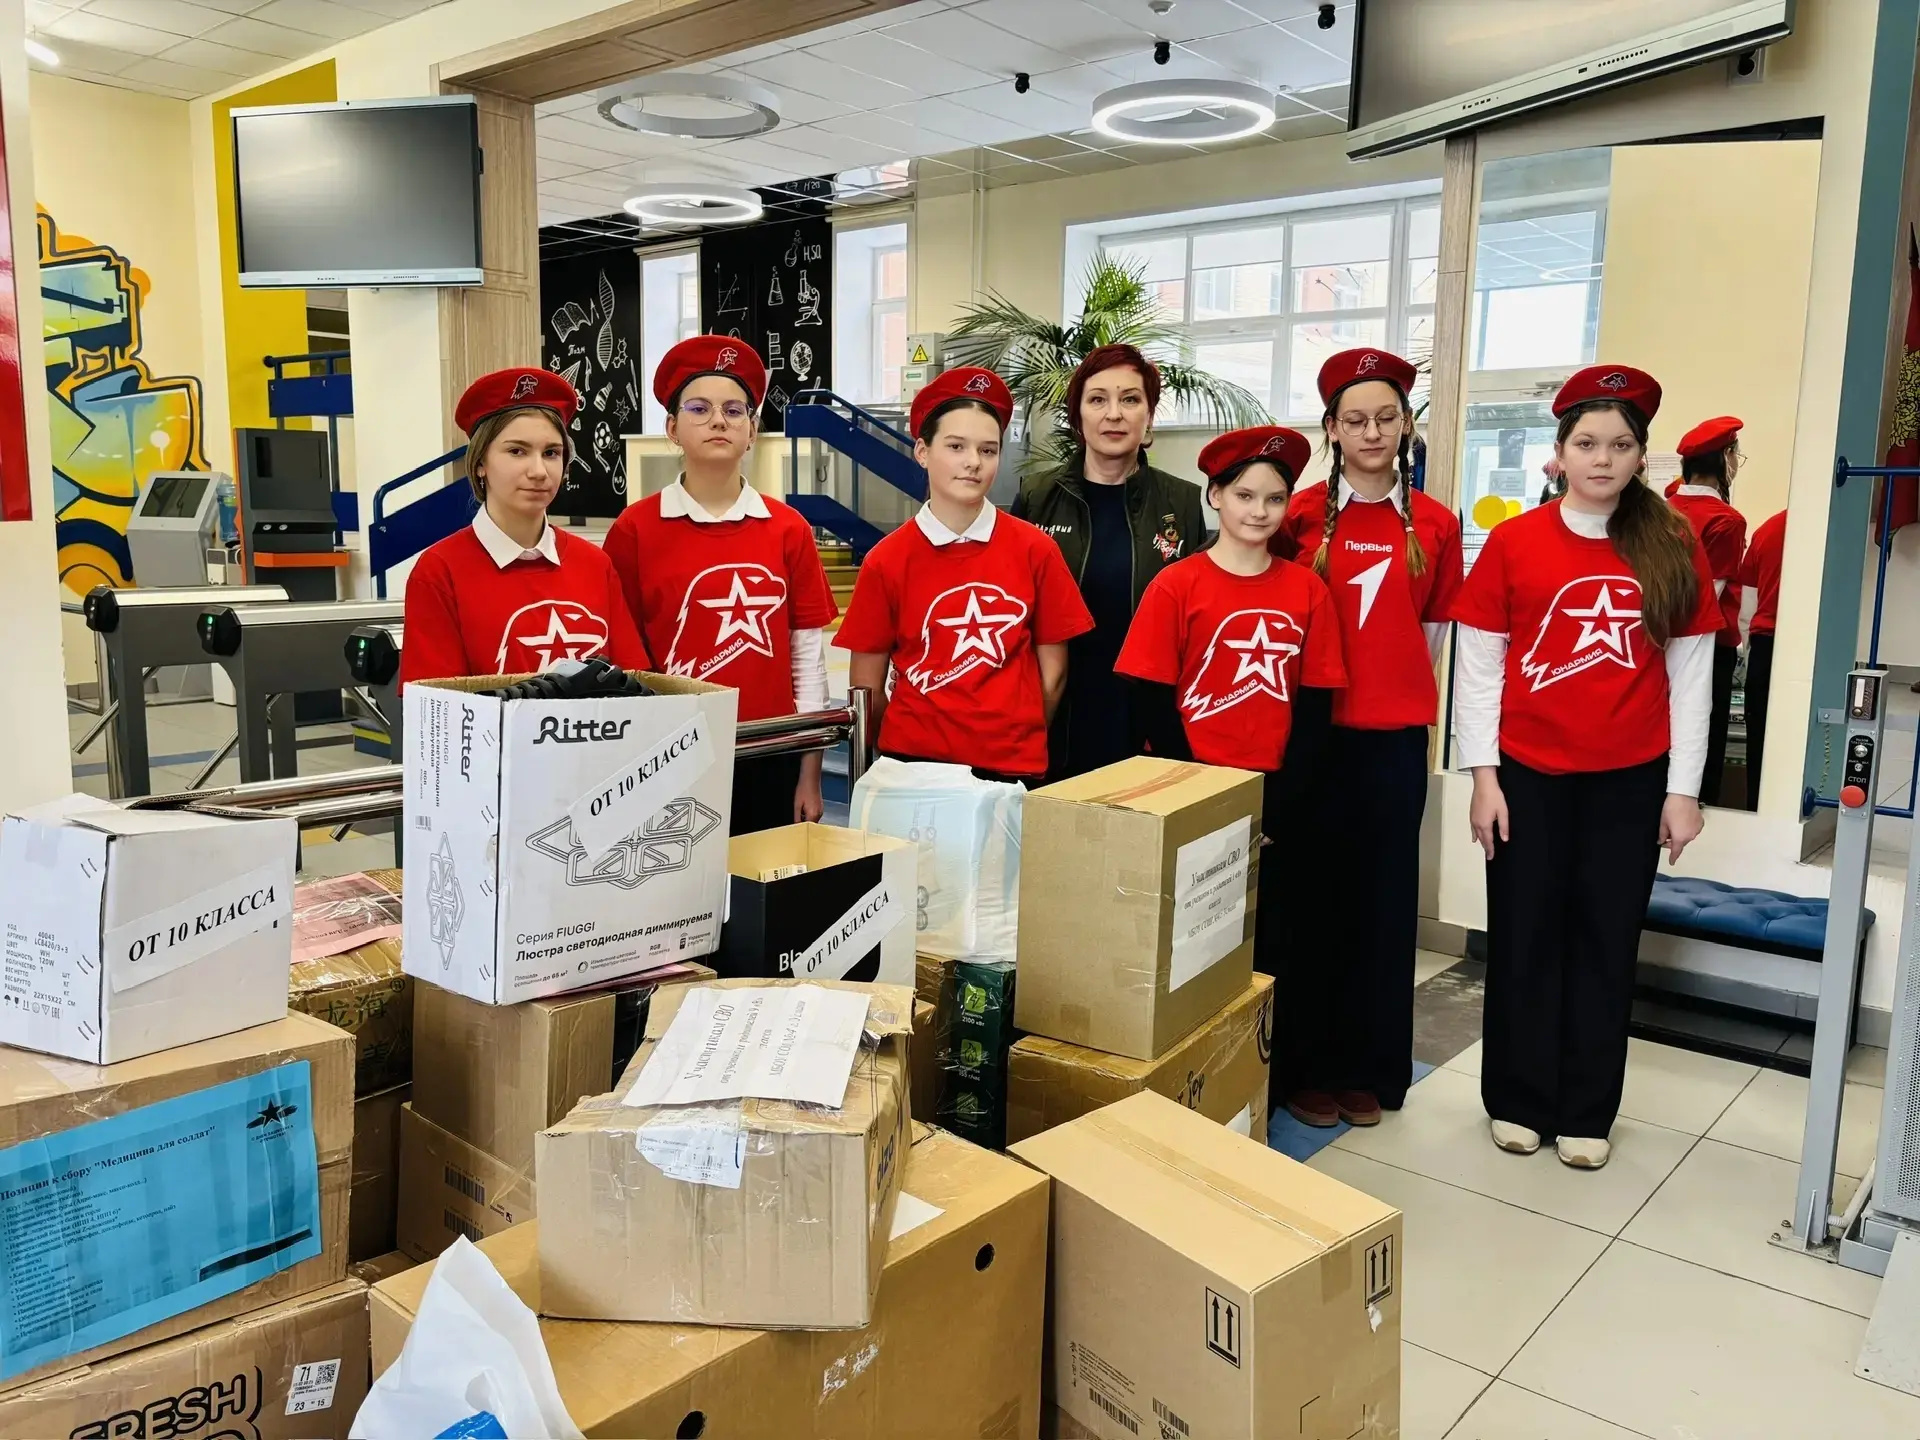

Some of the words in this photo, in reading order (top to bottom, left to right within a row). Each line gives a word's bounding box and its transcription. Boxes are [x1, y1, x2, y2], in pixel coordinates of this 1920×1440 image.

[1345, 540, 1393, 553] Первые
[699, 637, 744, 672] ЮНАРМИЯ
[933, 653, 978, 683] ЮНАРМИЯ
[1551, 648, 1603, 676] ЮНАРМИЯ
[1213, 679, 1258, 707] ЮНАРМИЯ
[461, 703, 475, 783] Ritter
[533, 716, 631, 745] Ritter
[590, 788, 614, 818] ОТ
[618, 775, 634, 799] 10
[637, 728, 700, 784] КЛАССА
[129, 932, 160, 962] ОТ
[168, 922, 188, 949] 10
[195, 885, 276, 936] КЛАССА
[515, 946, 564, 962] Люстра
[566, 928, 644, 952] светодиодная
[644, 911, 713, 936] диммируемая
[516, 930, 554, 945] Серия
[556, 922, 596, 939] FIUGGI
[807, 949, 824, 974] ОТ
[826, 931, 840, 956] 10
[841, 890, 889, 943] КЛАССА
[713, 1004, 735, 1022] СВО
[0, 1180, 50, 1201] Позиции
[52, 1176, 59, 1184] к
[61, 1167, 93, 1182] сбору
[94, 1146, 155, 1169] "Медицина
[157, 1139, 175, 1152] для
[177, 1125, 216, 1145] солдат"
[300, 1366, 311, 1381] 71
[294, 1401, 305, 1411] 23
